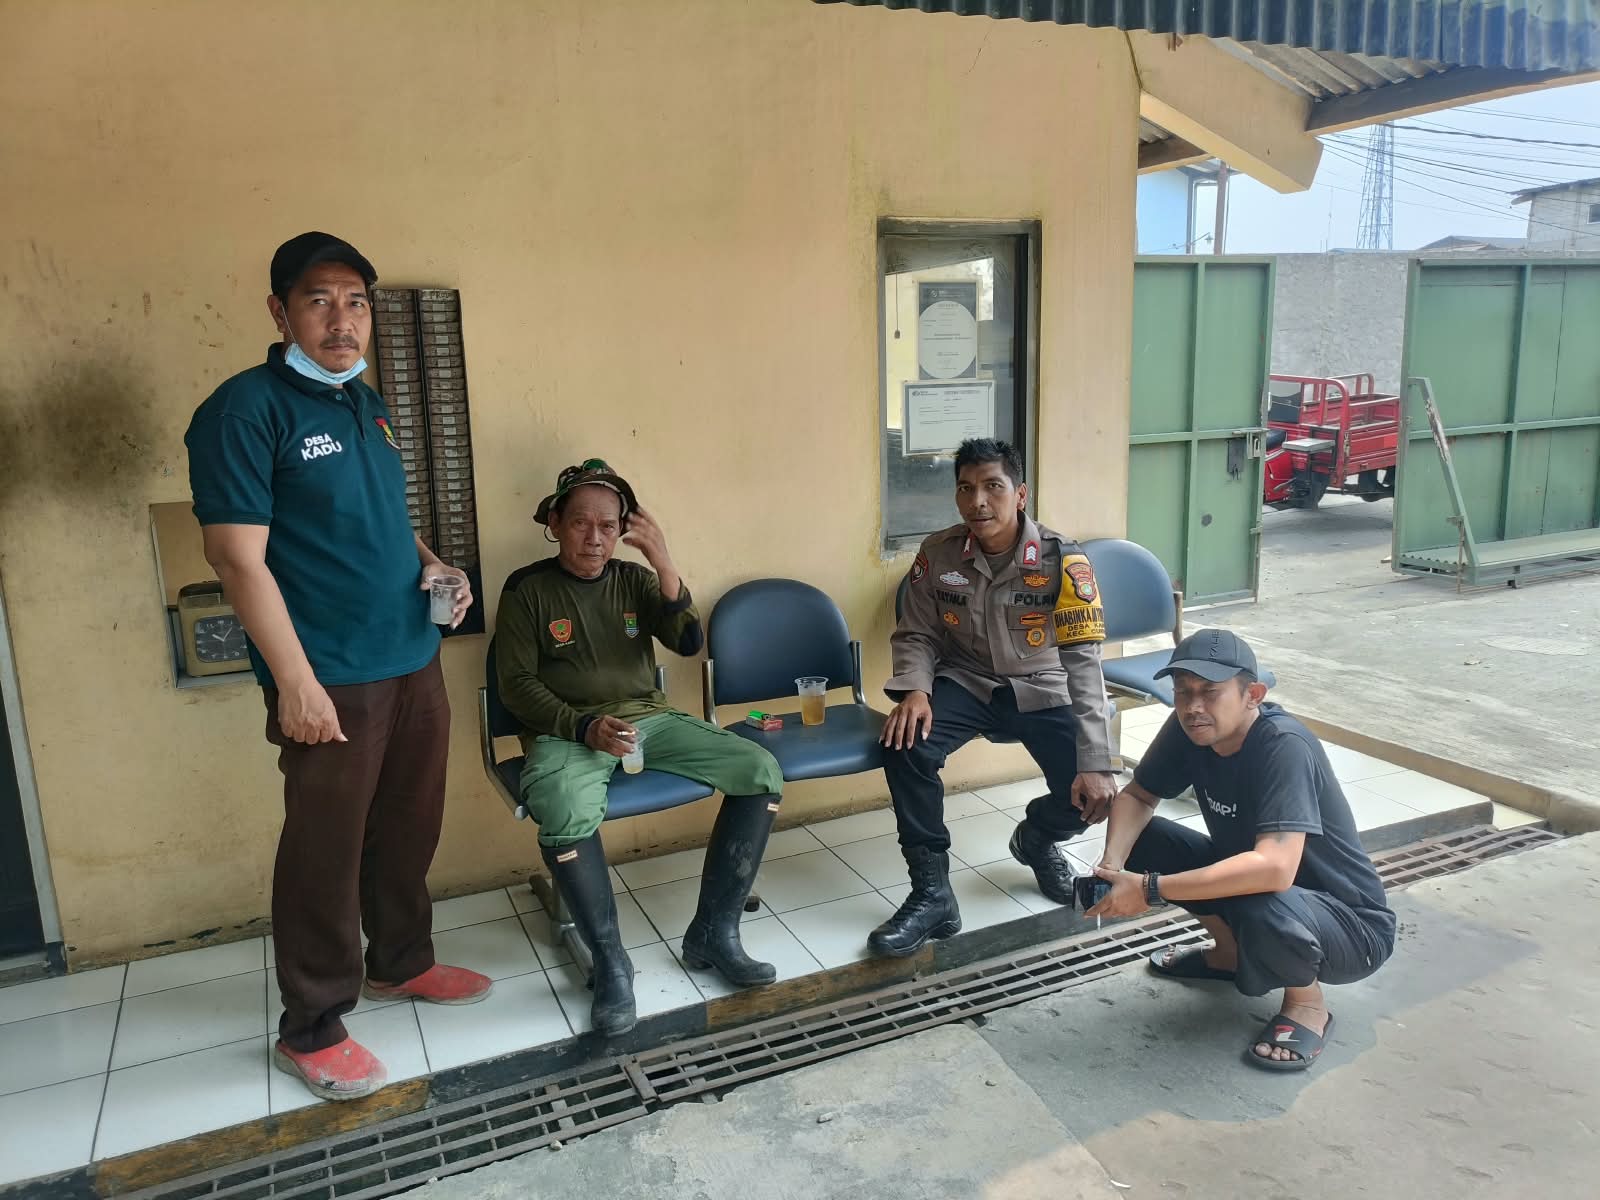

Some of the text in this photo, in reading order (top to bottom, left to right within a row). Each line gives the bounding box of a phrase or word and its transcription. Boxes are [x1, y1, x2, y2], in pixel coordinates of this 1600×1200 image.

[303, 432, 333, 447] DESA
[301, 441, 343, 461] KADU
[1067, 623, 1090, 631] DESA
